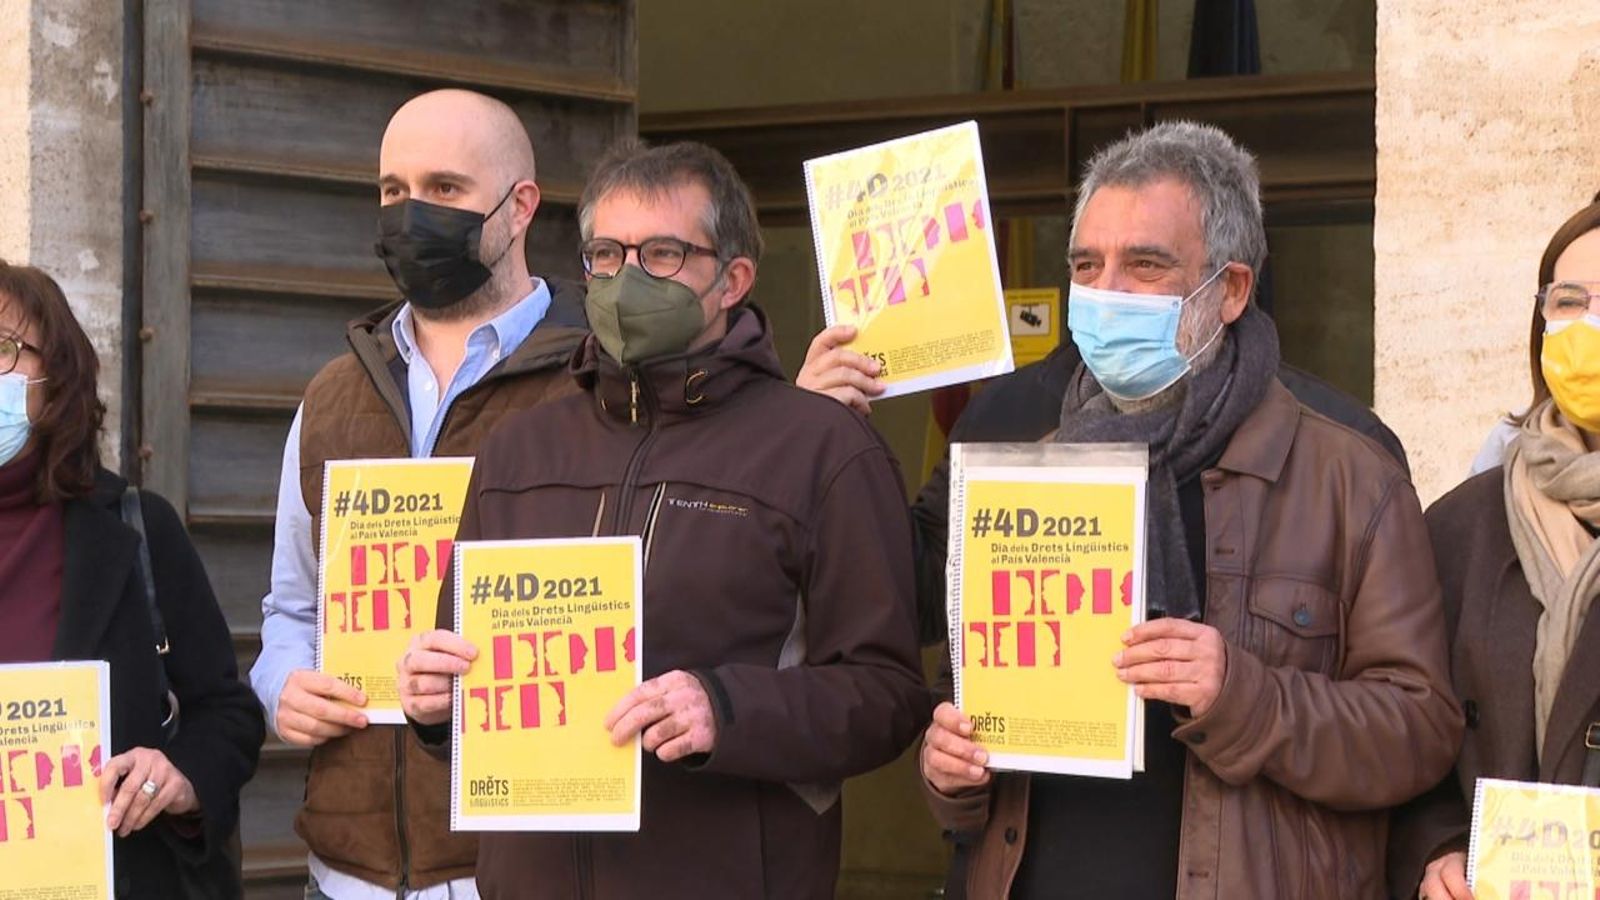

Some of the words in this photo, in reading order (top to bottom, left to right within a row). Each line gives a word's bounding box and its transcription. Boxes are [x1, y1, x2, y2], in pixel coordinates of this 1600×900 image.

[334, 488, 390, 517] #4D
[394, 493, 443, 513] 2021
[350, 520, 365, 531] Dia
[384, 517, 411, 528] Drets
[972, 508, 1039, 538] #4D
[1043, 516, 1102, 536] 2021
[991, 543, 1008, 553] Dia
[1032, 543, 1063, 552] Drets
[471, 573, 540, 604] #4D
[544, 577, 602, 599] 2021
[492, 608, 509, 619] Dia
[533, 605, 565, 615] Drets
[6, 697, 67, 720] 2021
